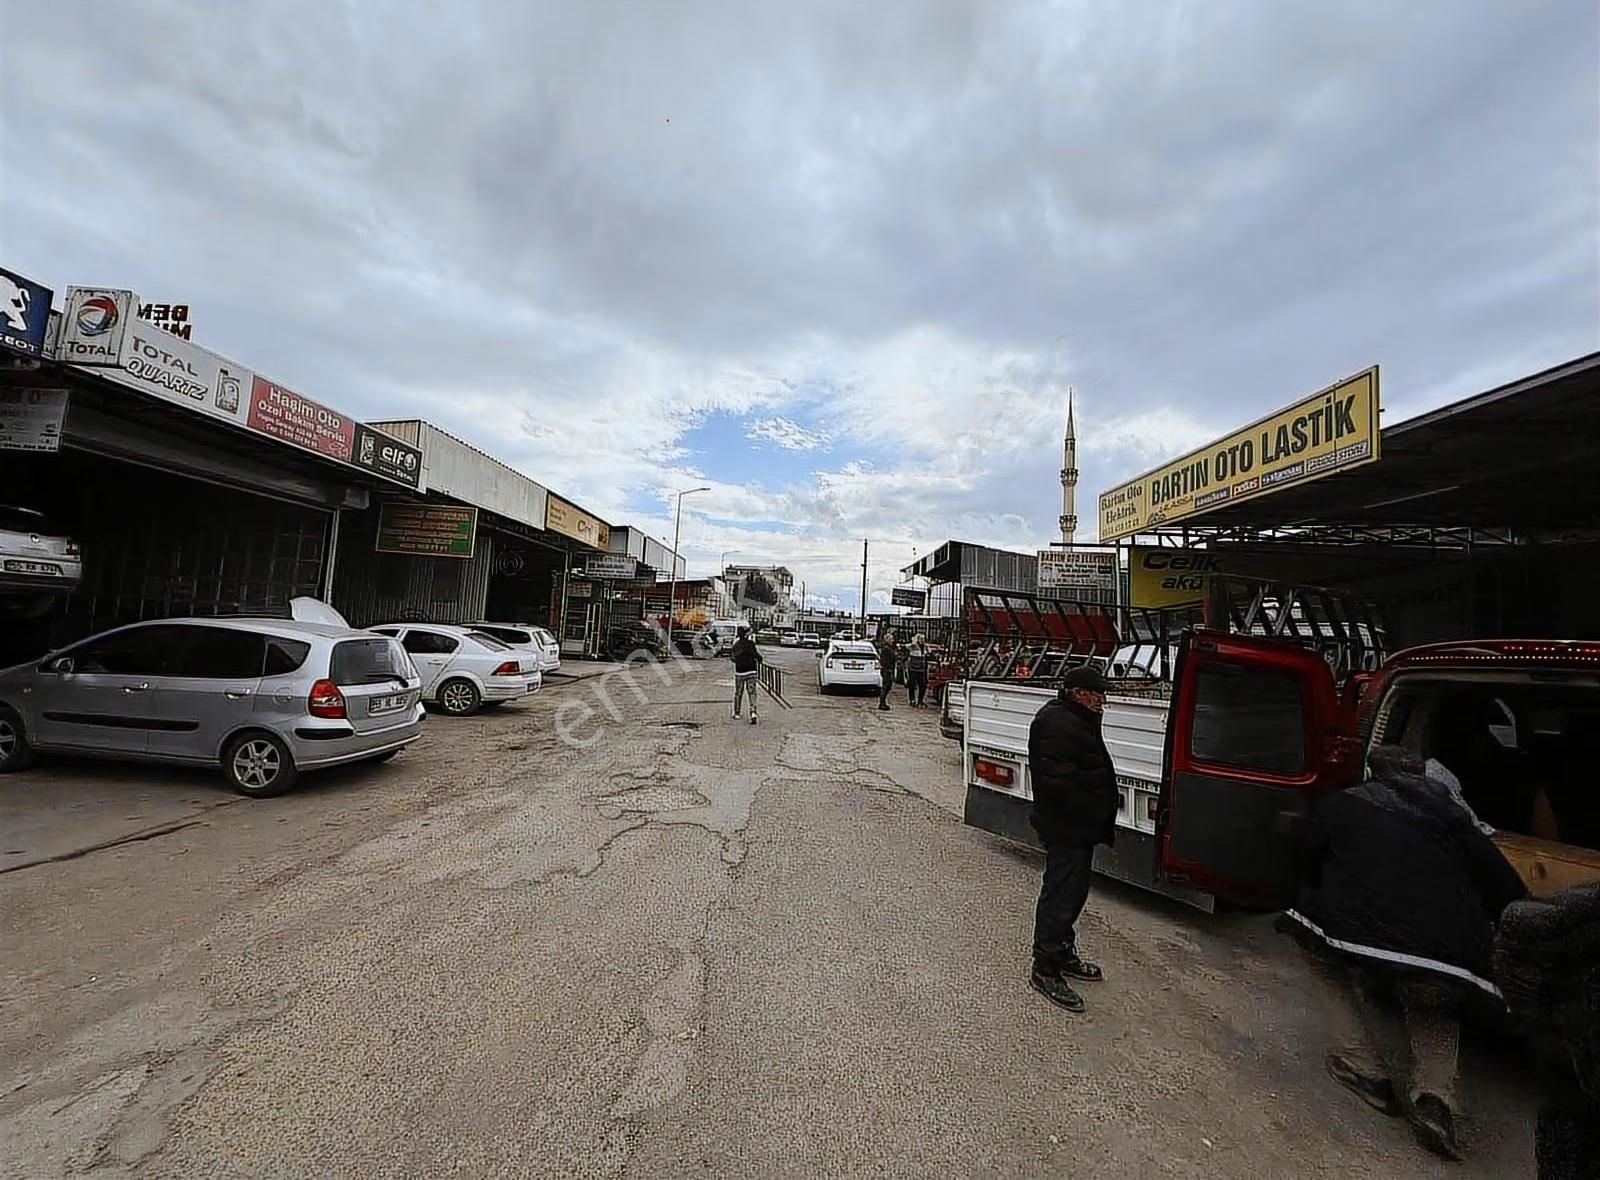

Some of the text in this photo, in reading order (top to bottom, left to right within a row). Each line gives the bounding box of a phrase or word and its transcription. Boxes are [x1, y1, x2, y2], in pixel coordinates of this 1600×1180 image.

[67, 340, 117, 357] TOTAL
[132, 335, 199, 377] TOTAL
[125, 357, 208, 402] QUARTZ
[318, 406, 341, 430] Oto
[382, 445, 404, 465] elf
[1151, 394, 1357, 507] BARTIN OTO LASTİK
[1127, 484, 1143, 500] Oto
